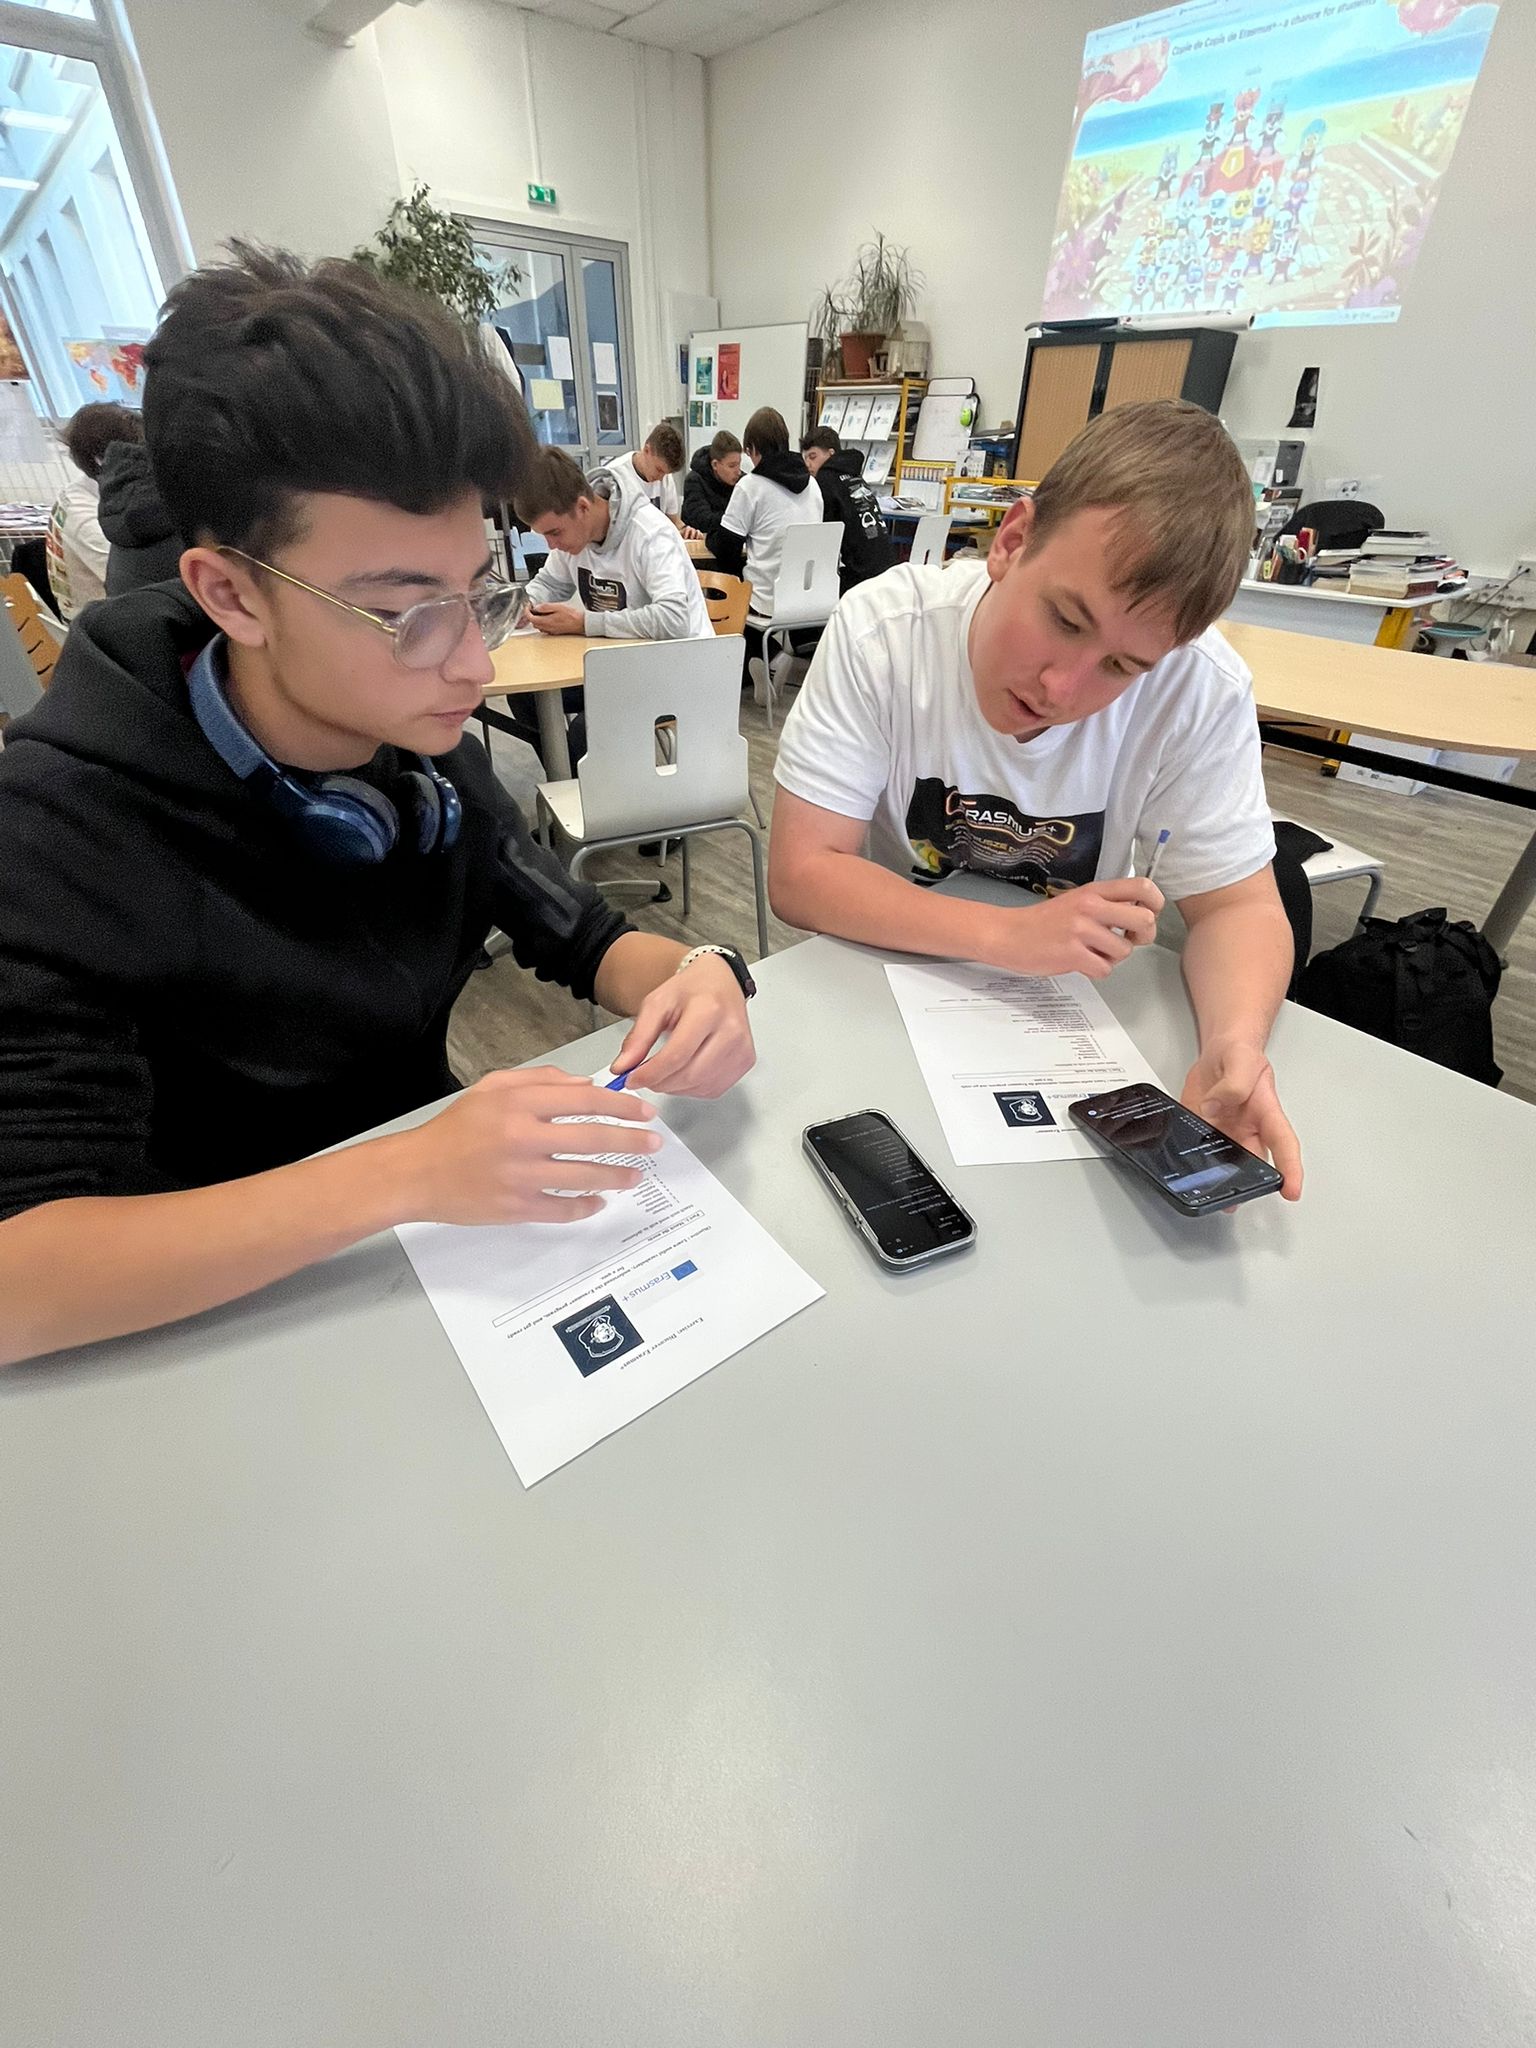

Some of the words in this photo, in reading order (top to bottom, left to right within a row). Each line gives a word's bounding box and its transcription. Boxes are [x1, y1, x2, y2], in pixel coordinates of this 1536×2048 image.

[1323, 6, 1335, 17] for
[963, 808, 1058, 837] RASMUS+
[619, 1270, 671, 1302] Erasmus+
